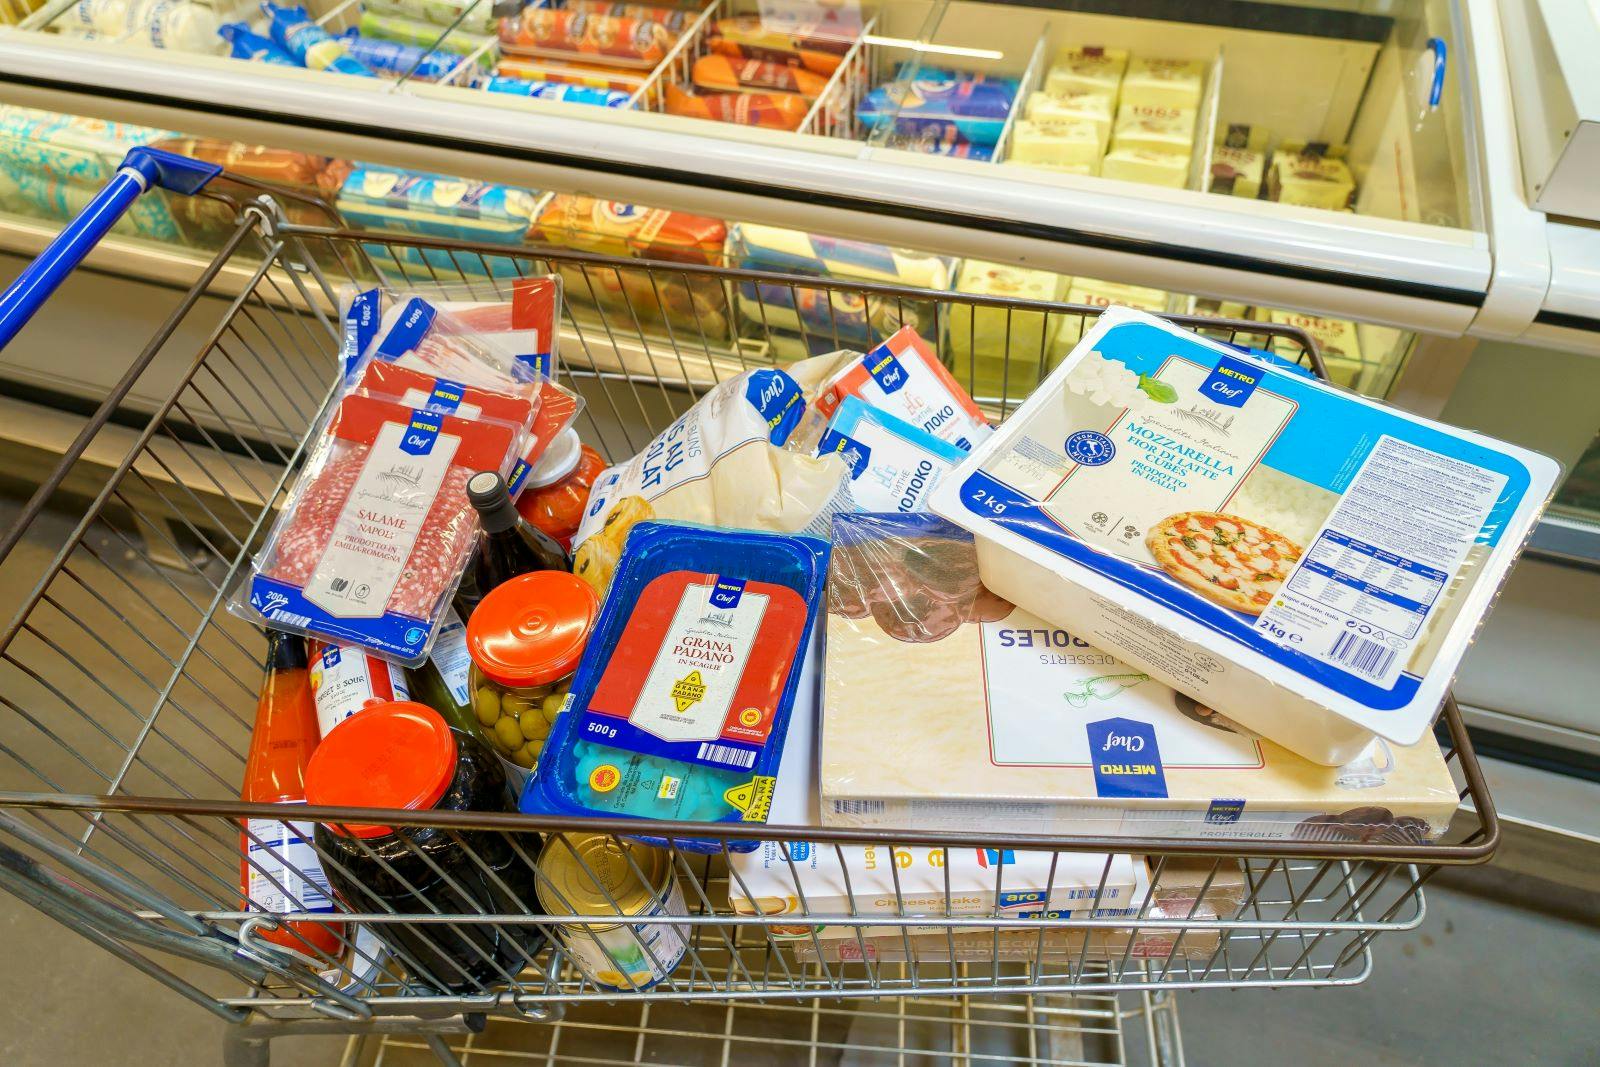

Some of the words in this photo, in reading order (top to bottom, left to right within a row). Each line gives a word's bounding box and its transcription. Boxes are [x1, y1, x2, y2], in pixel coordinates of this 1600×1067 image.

[871, 355, 894, 376] METRO
[882, 367, 900, 387] Chef
[1218, 366, 1255, 385] METRO
[435, 390, 460, 402] METRO
[760, 374, 785, 412] Chef
[1211, 381, 1243, 399] Chef
[411, 421, 438, 433] METRO
[922, 405, 954, 434] ЛОКО
[407, 434, 431, 449] Chef
[1126, 422, 1234, 476] MOZZARELLA
[1126, 435, 1158, 457] FIOR
[1159, 448, 1177, 462] DI
[1178, 457, 1219, 481] LATTE
[1144, 454, 1188, 477] CUBES
[1131, 459, 1187, 488] PRODOTTO
[1131, 467, 1145, 478] IN
[1144, 473, 1177, 492] ITALIA
[971, 489, 987, 502] 2
[984, 495, 1007, 514] kg
[357, 509, 408, 530] SALAME
[334, 541, 401, 563] EMILIA-ROMAGNA
[345, 535, 388, 552] PRODOTTO
[388, 546, 398, 554] IN
[718, 583, 742, 592] METRO
[715, 593, 736, 604] Chef
[1259, 620, 1270, 629] 2
[1268, 623, 1286, 639] kg
[682, 636, 733, 653] GRANA
[673, 645, 734, 664] PADANO
[1039, 654, 1115, 665] DESSERTS
[677, 658, 687, 666] IN
[688, 660, 721, 671] SCAGLIE
[343, 675, 365, 688] SOUR
[675, 683, 704, 694] GRANA
[672, 689, 702, 699] PADANO
[1102, 731, 1145, 752] Chef
[1100, 764, 1157, 775] METRO
[1210, 812, 1234, 822] Chef
[1006, 891, 1039, 902] aro
